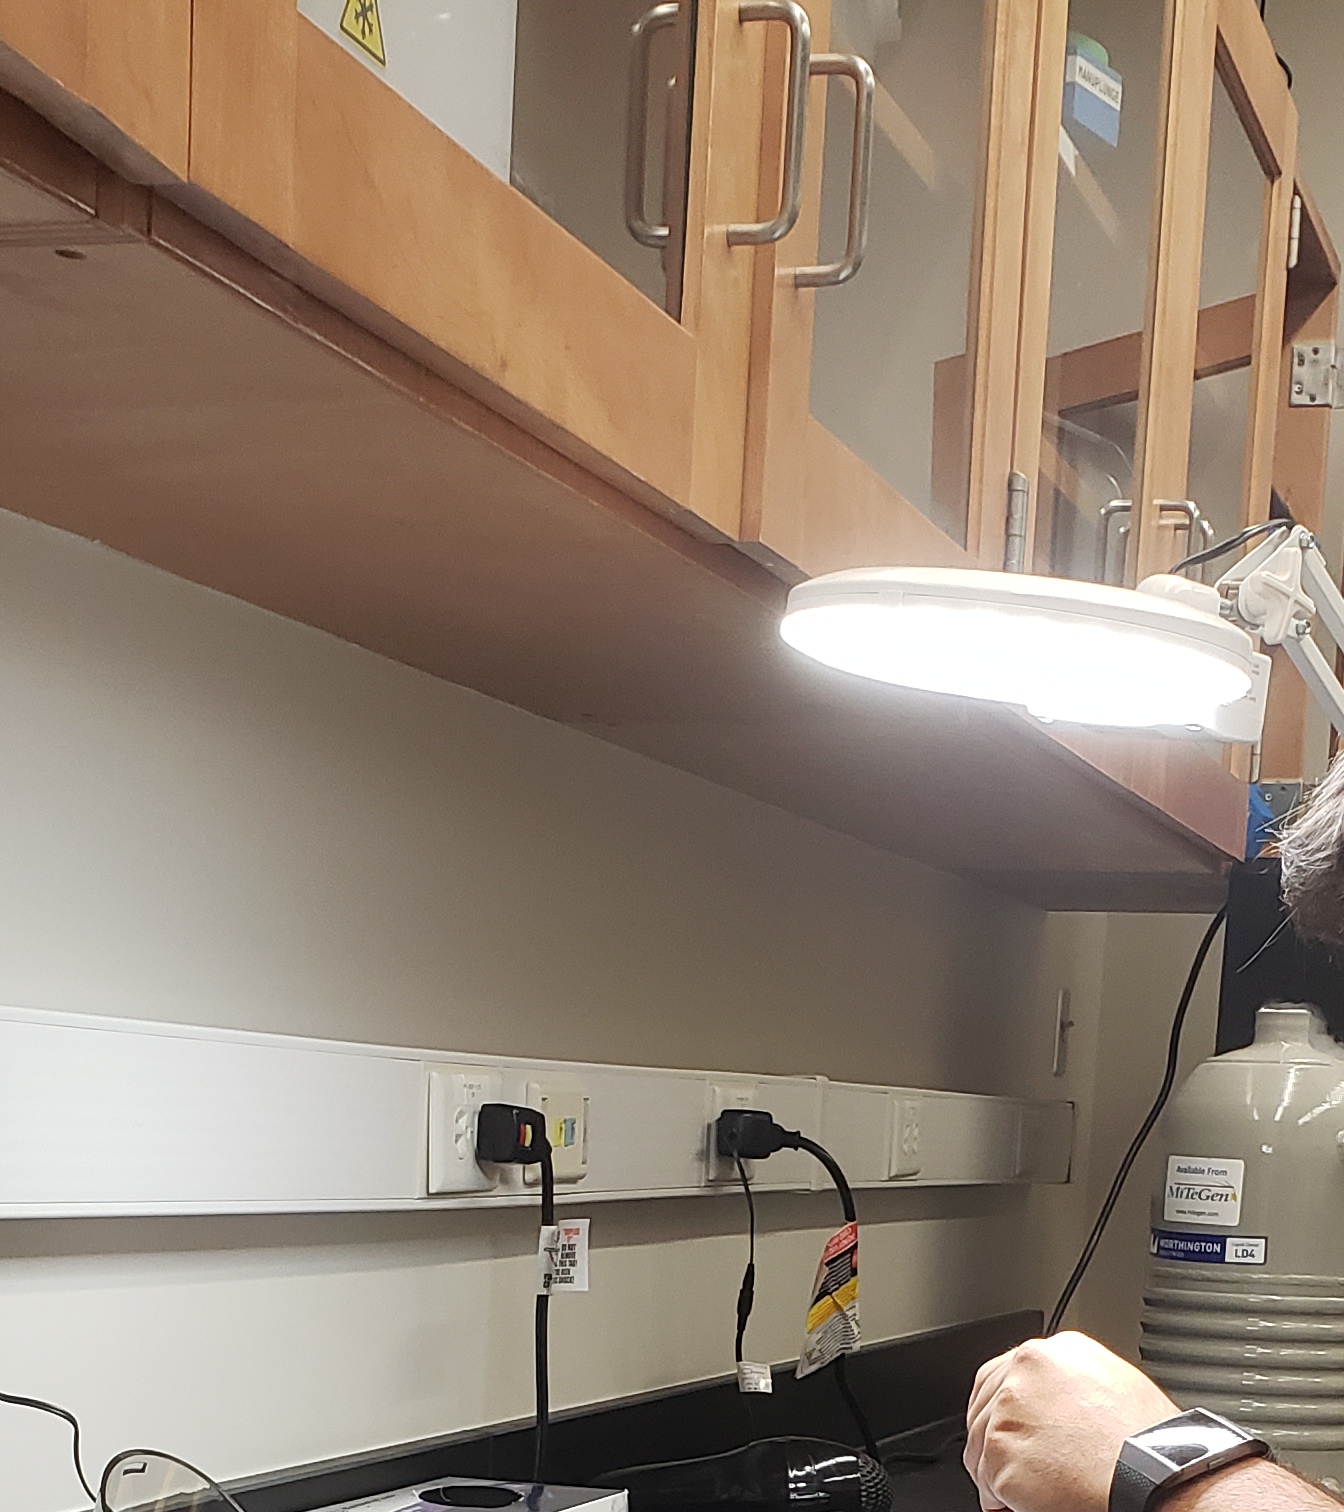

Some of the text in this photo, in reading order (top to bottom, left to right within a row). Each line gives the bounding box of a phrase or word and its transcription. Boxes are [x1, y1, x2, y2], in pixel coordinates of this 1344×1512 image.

[1207, 1167, 1228, 1177] From
[1168, 1185, 1229, 1202] MiTeGen
[1235, 1249, 1256, 1259] LD4
